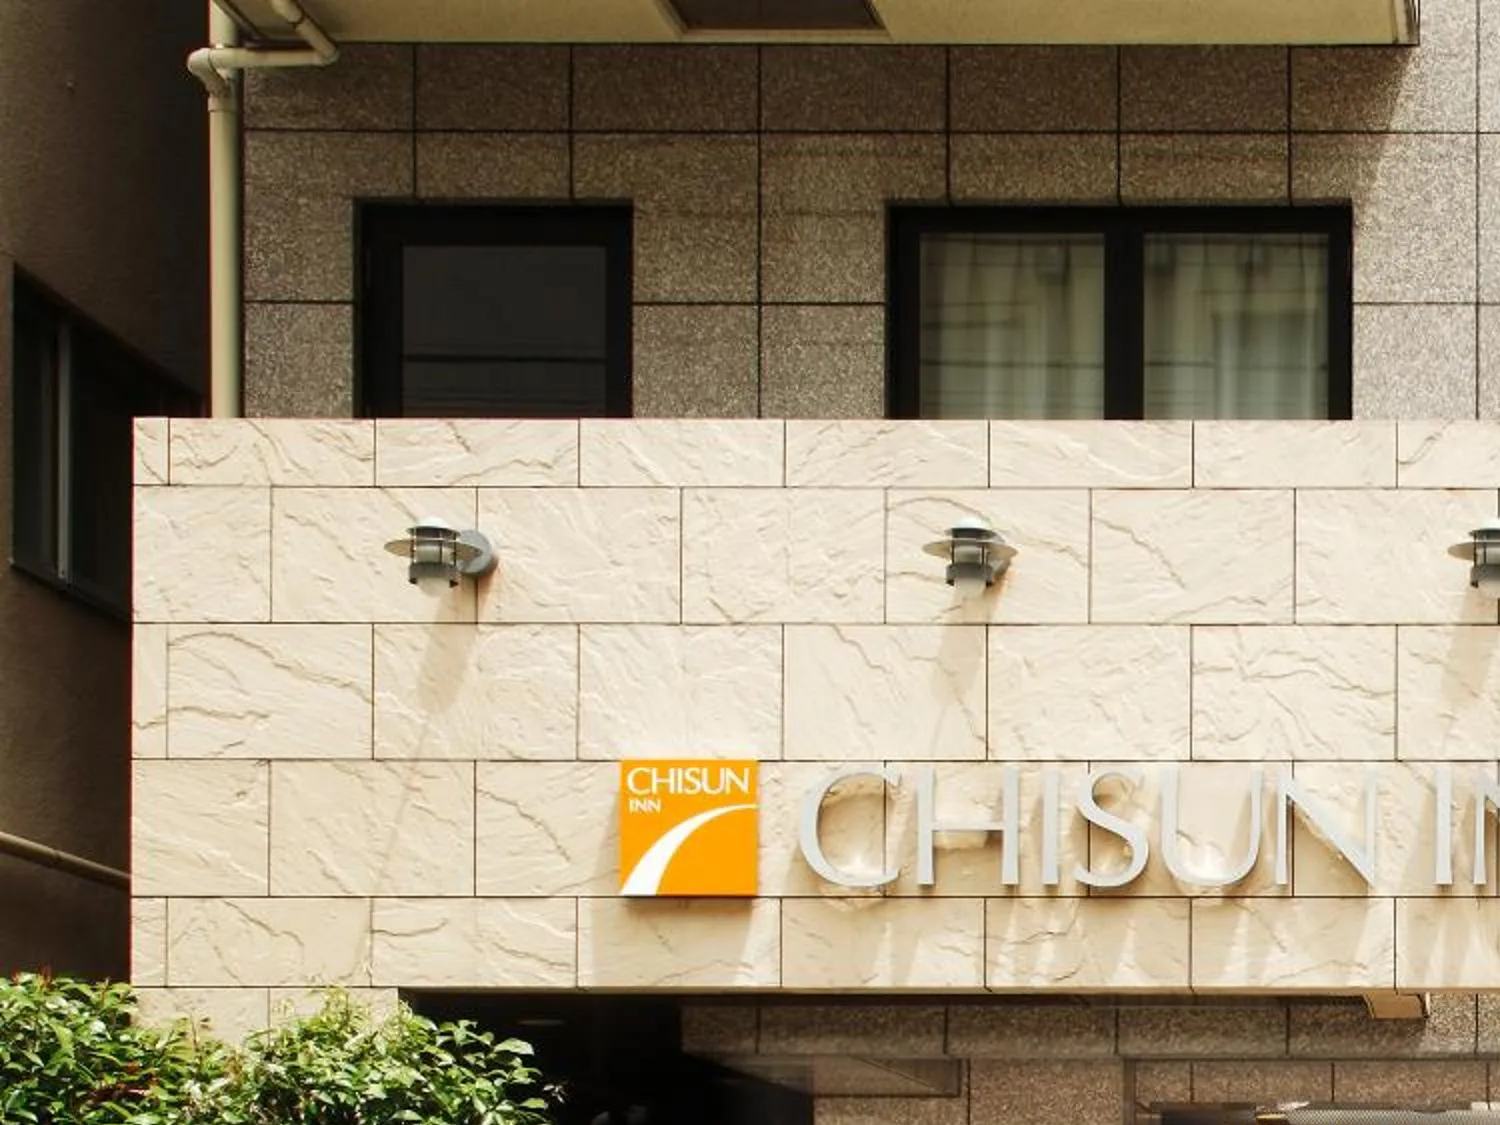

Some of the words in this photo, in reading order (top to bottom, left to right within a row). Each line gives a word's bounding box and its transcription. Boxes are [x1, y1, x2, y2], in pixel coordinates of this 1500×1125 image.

[626, 767, 749, 795] CHISUN
[629, 799, 662, 814] INN
[799, 769, 1379, 889] CHISUN
